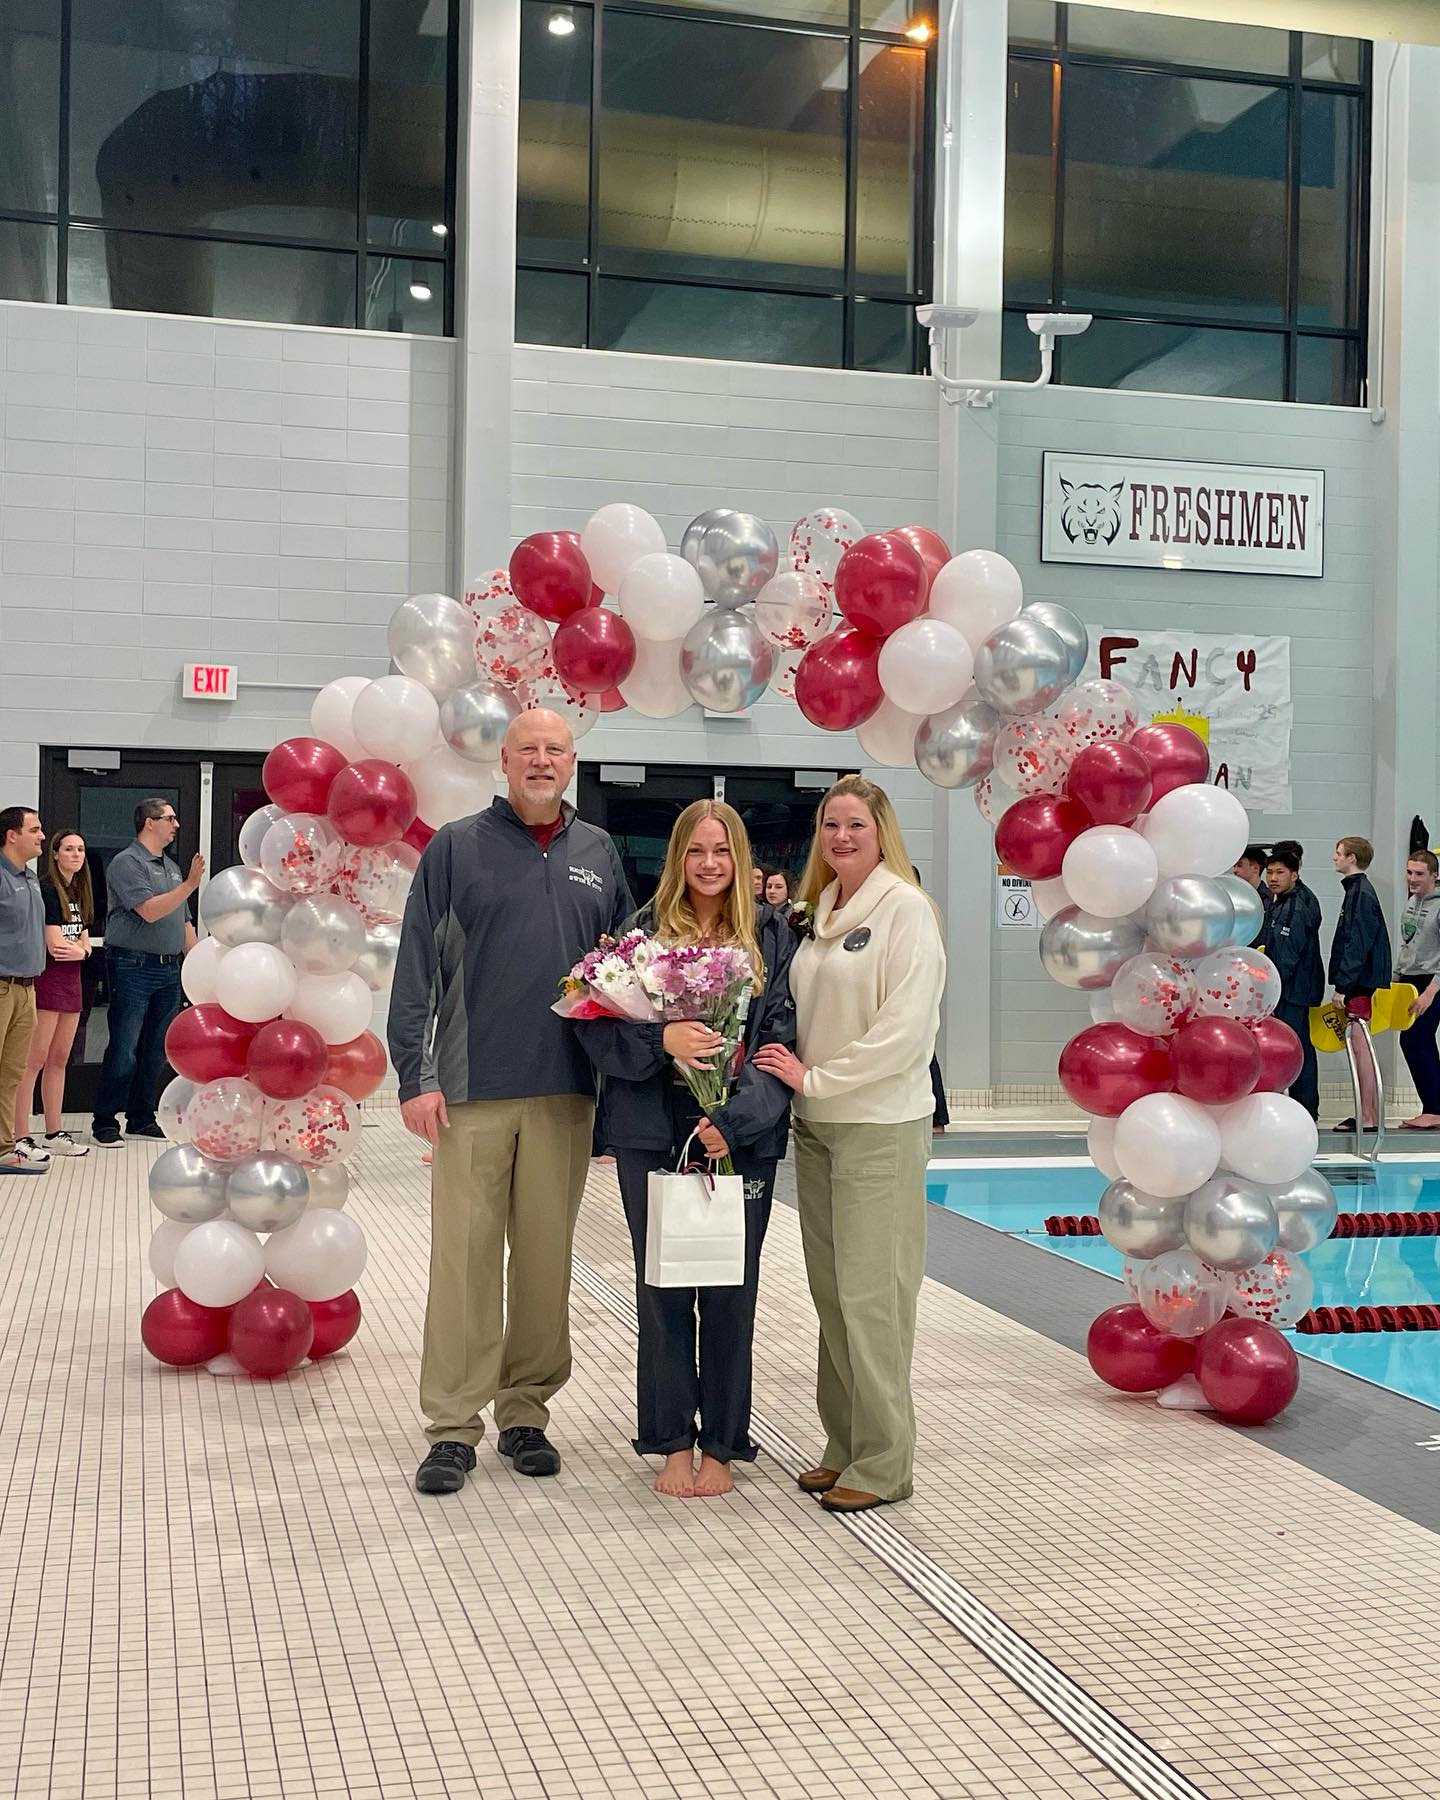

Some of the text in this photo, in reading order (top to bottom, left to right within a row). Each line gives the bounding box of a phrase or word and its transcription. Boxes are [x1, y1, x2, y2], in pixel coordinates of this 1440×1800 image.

[1129, 483, 1309, 551] FRESHMEN
[194, 667, 229, 693] EXIT
[1100, 637, 1256, 691] FANCY
[1002, 878, 1011, 888] NO
